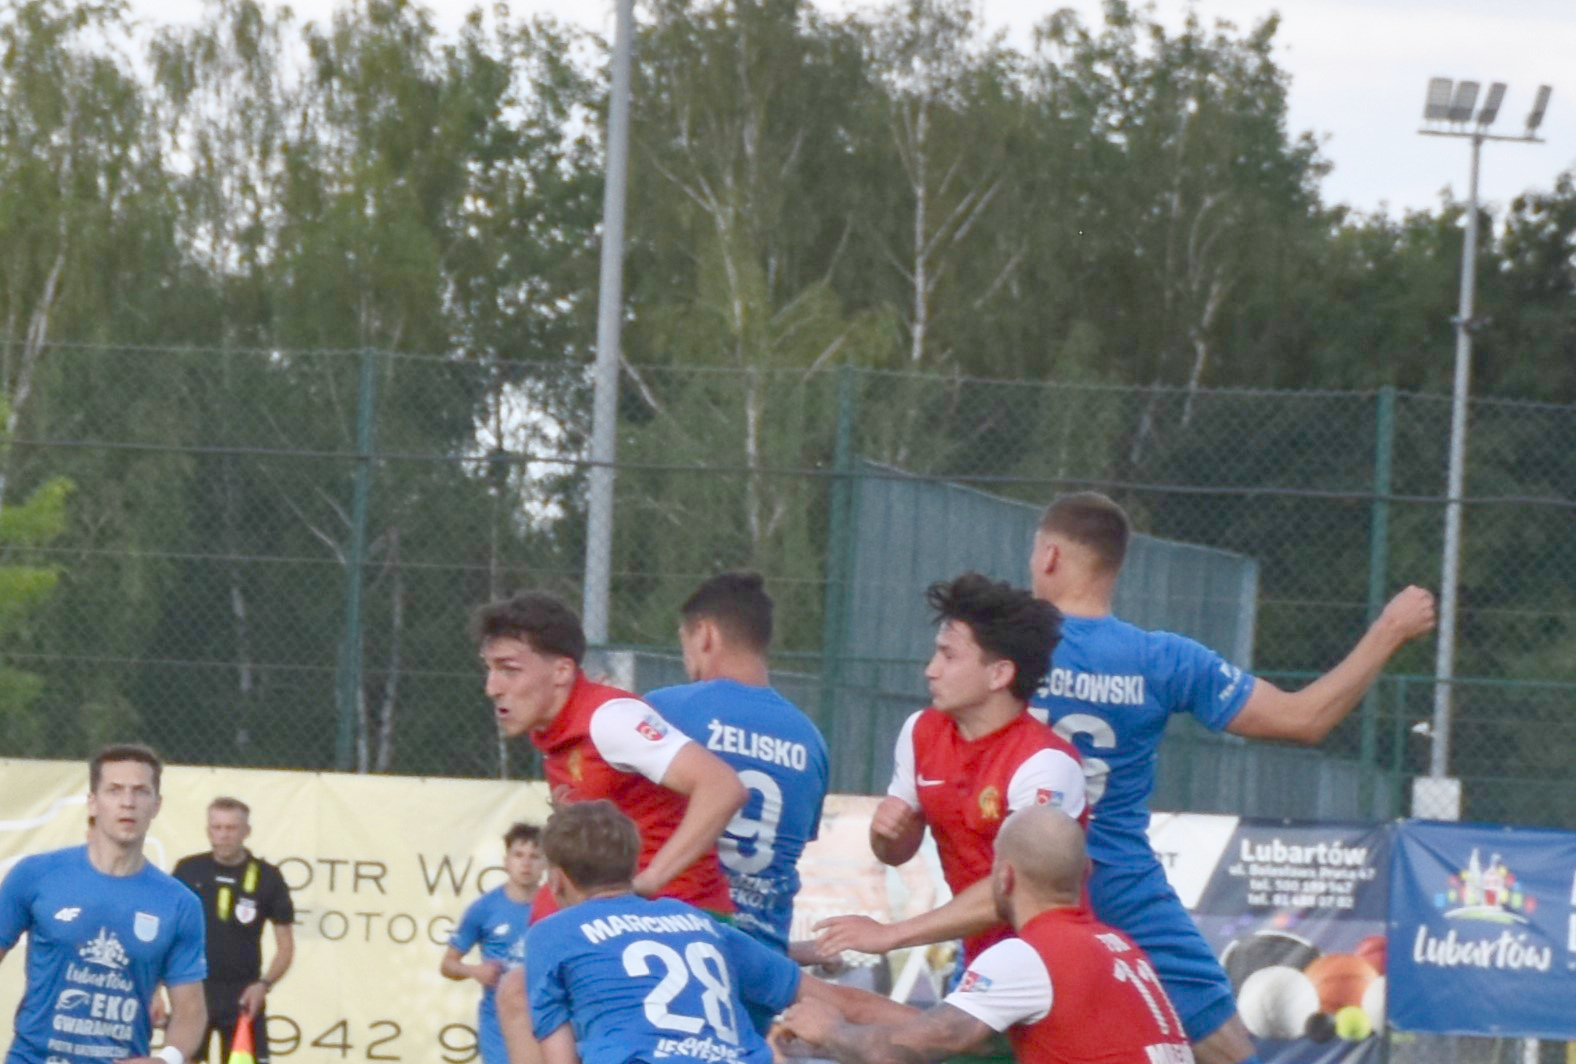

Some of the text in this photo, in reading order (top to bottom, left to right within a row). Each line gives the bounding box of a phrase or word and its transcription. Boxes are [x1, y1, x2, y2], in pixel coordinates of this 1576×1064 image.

[706, 718, 808, 772] ŻELISKO
[716, 768, 784, 875] 9
[276, 856, 389, 896] OTR
[1240, 838, 1367, 866] Lubartów
[1413, 924, 1553, 972] Lubartów
[90, 992, 139, 1023] EKO
[621, 939, 740, 1046] 28
[1113, 957, 1188, 1038] 11
